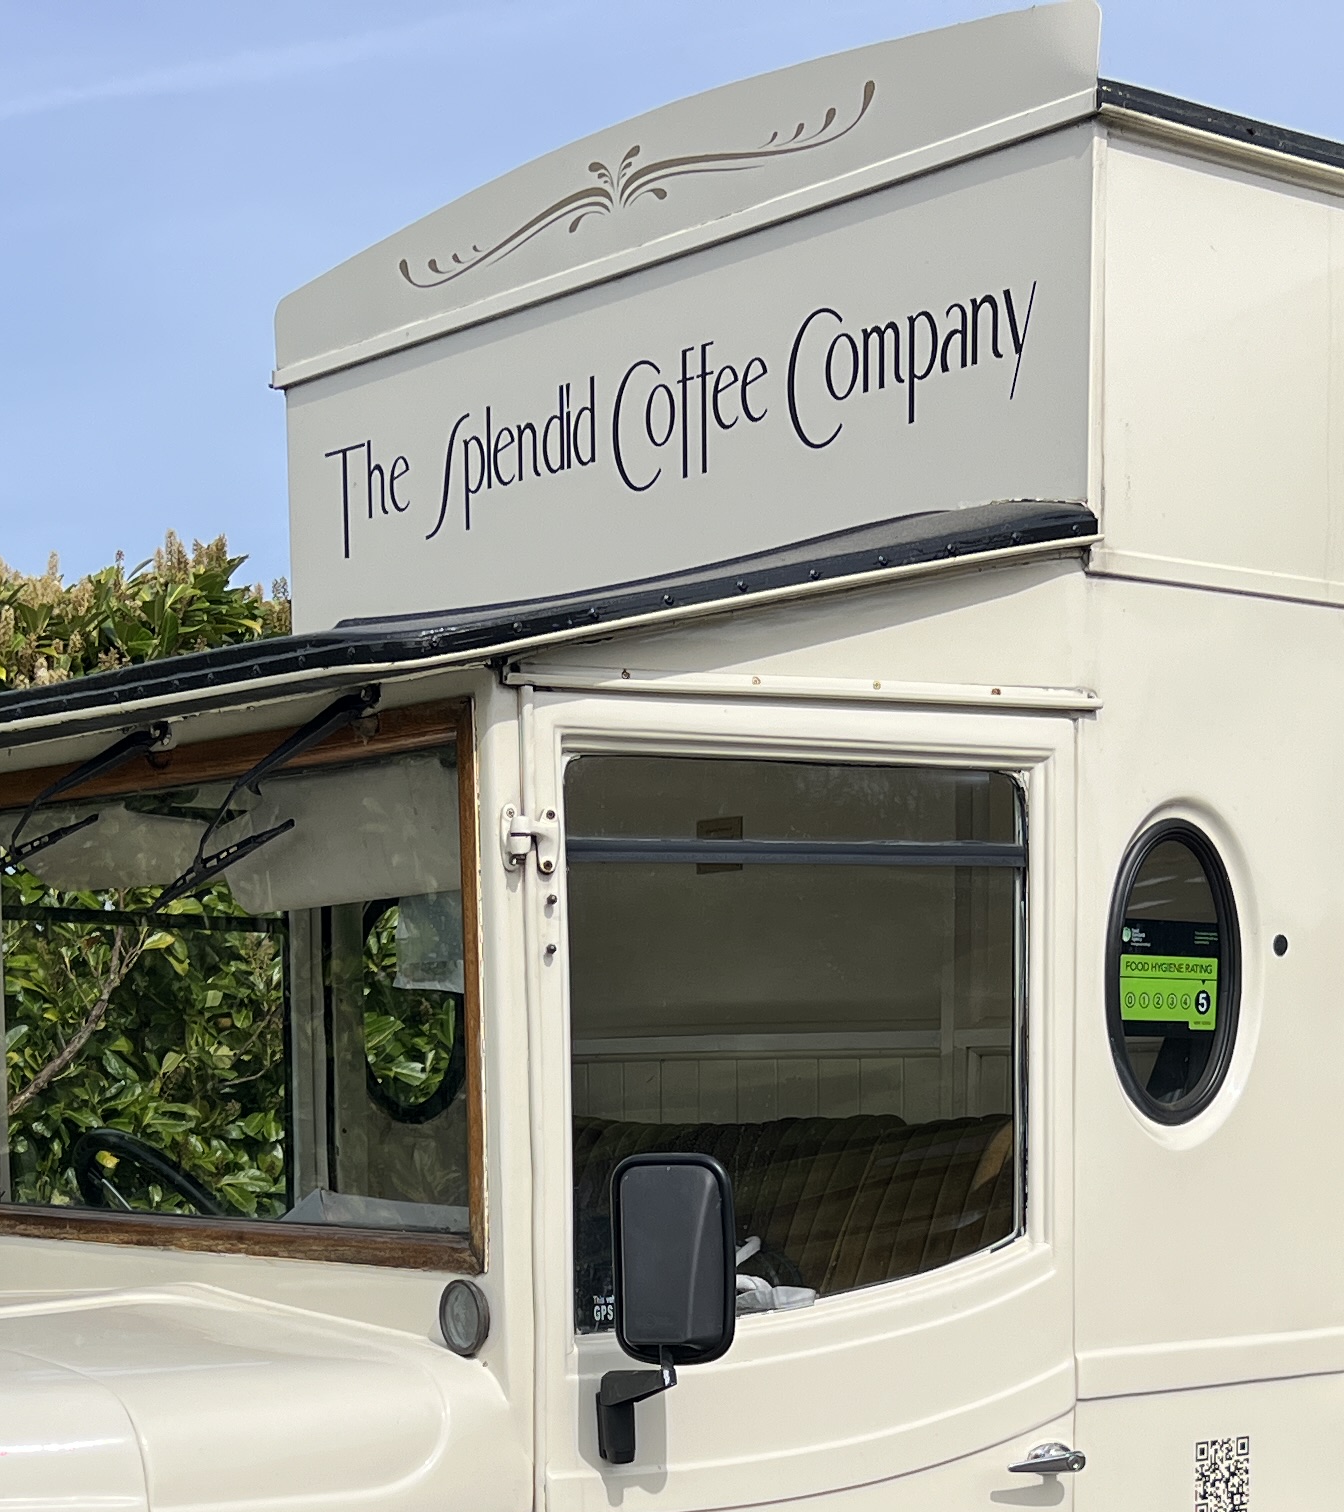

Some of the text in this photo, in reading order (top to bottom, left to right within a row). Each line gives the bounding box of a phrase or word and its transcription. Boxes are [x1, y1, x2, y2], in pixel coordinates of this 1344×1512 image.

[325, 281, 1037, 559] The Splendid Coffee Company
[1125, 961, 1213, 975] FOOD HYGIENE RATING
[594, 1305, 614, 1321] GPS
